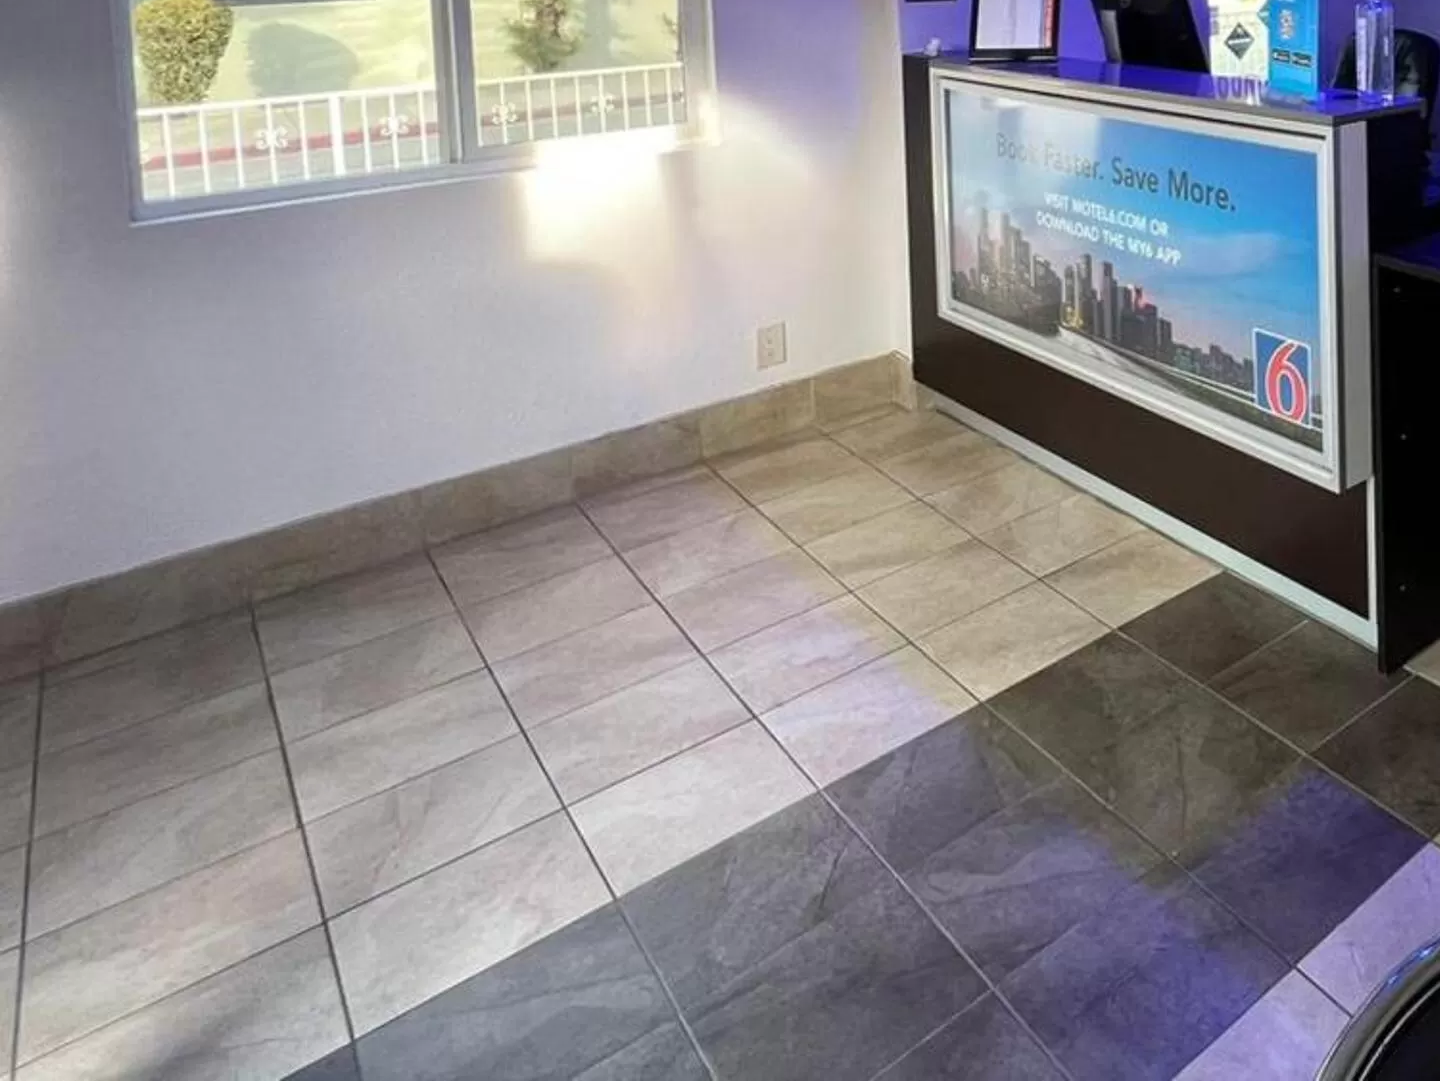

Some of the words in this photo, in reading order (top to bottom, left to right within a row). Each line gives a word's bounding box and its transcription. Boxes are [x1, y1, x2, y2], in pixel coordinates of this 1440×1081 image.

[1112, 157, 1160, 194] Save
[1167, 168, 1237, 212] More.
[1036, 211, 1099, 242] DOWNLOAD
[1102, 228, 1126, 251] THE
[1154, 247, 1182, 265] APP
[1044, 191, 1069, 206] VISIT
[1150, 219, 1169, 238] OR
[1265, 340, 1306, 424] 6
